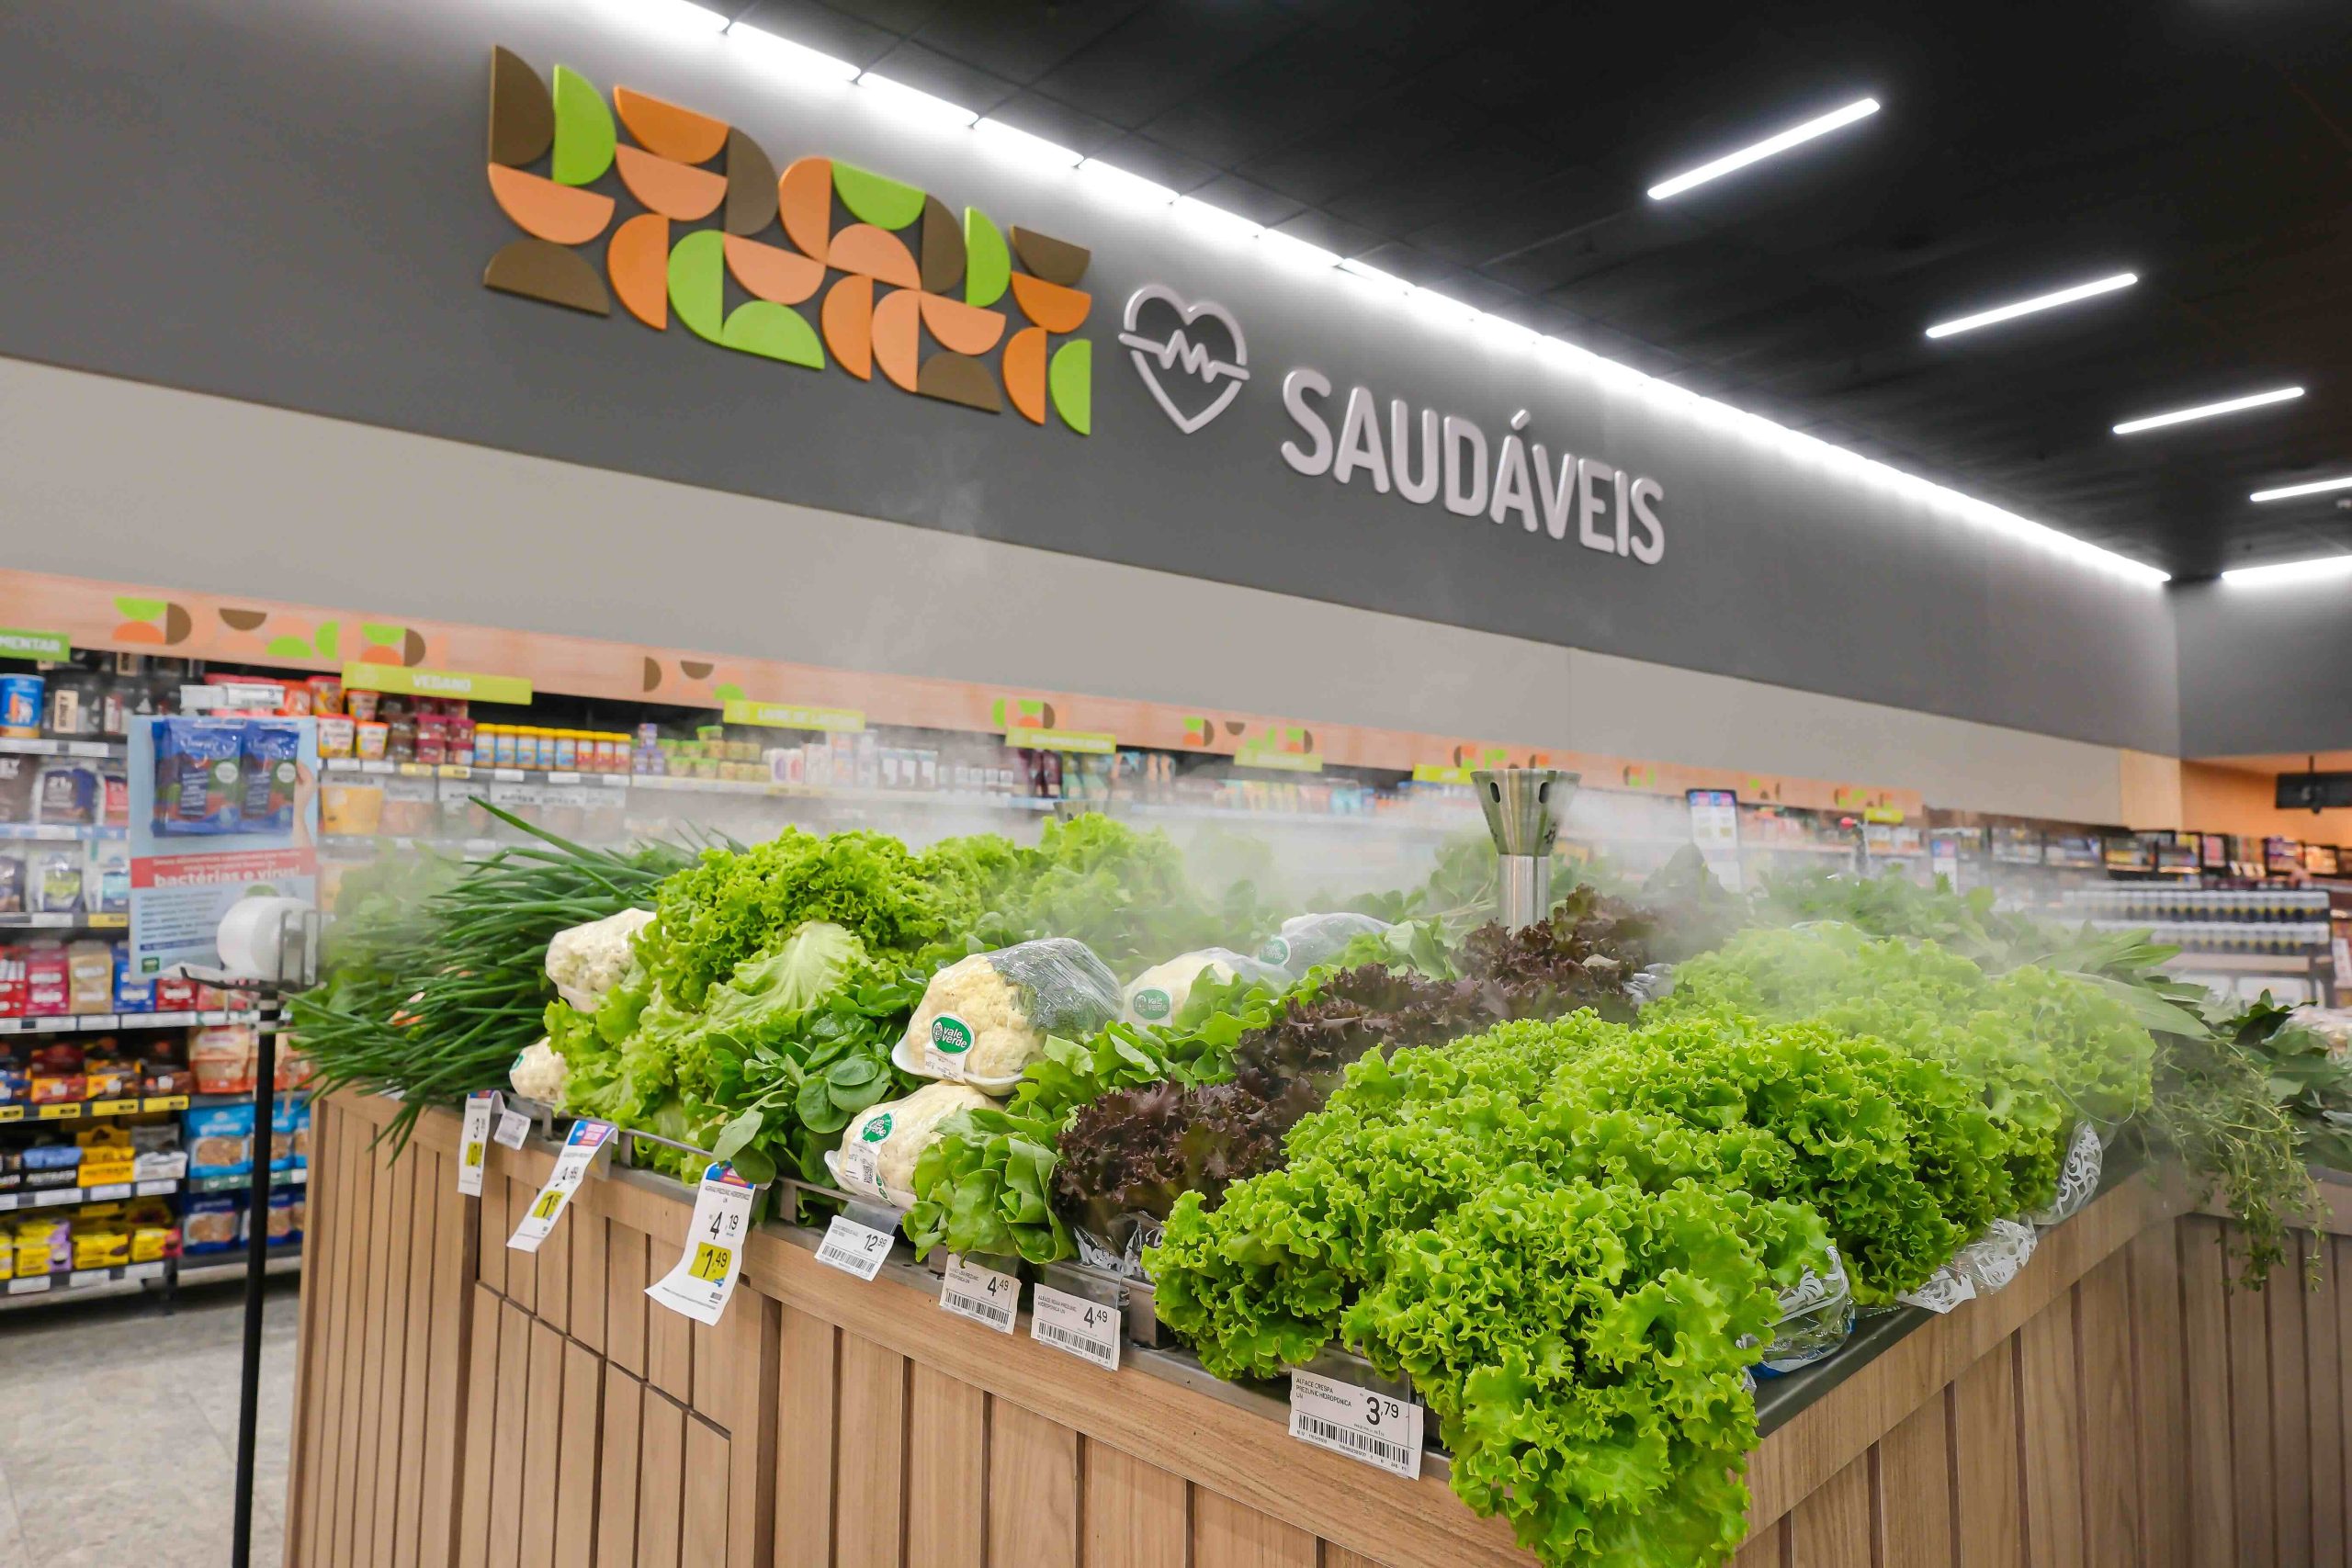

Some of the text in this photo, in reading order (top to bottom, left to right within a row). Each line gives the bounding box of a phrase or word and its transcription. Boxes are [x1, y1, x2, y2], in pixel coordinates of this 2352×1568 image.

[1281, 368, 1665, 565] SAUDÁVEIS
[413, 674, 471, 693] VEGANO
[153, 868, 240, 888] bactérias
[243, 869, 254, 881] e
[942, 1034, 967, 1048] verde
[944, 1027, 963, 1039] vale
[703, 1248, 728, 1278] 1,49
[987, 1276, 1010, 1297] 4,49
[1083, 1306, 1108, 1329] 4,49
[1295, 1377, 1333, 1394] ALFACE CRESPA
[1295, 1384, 1351, 1407] PREZUNIC HIDROPONICA
[1365, 1396, 1399, 1426] 3,79
